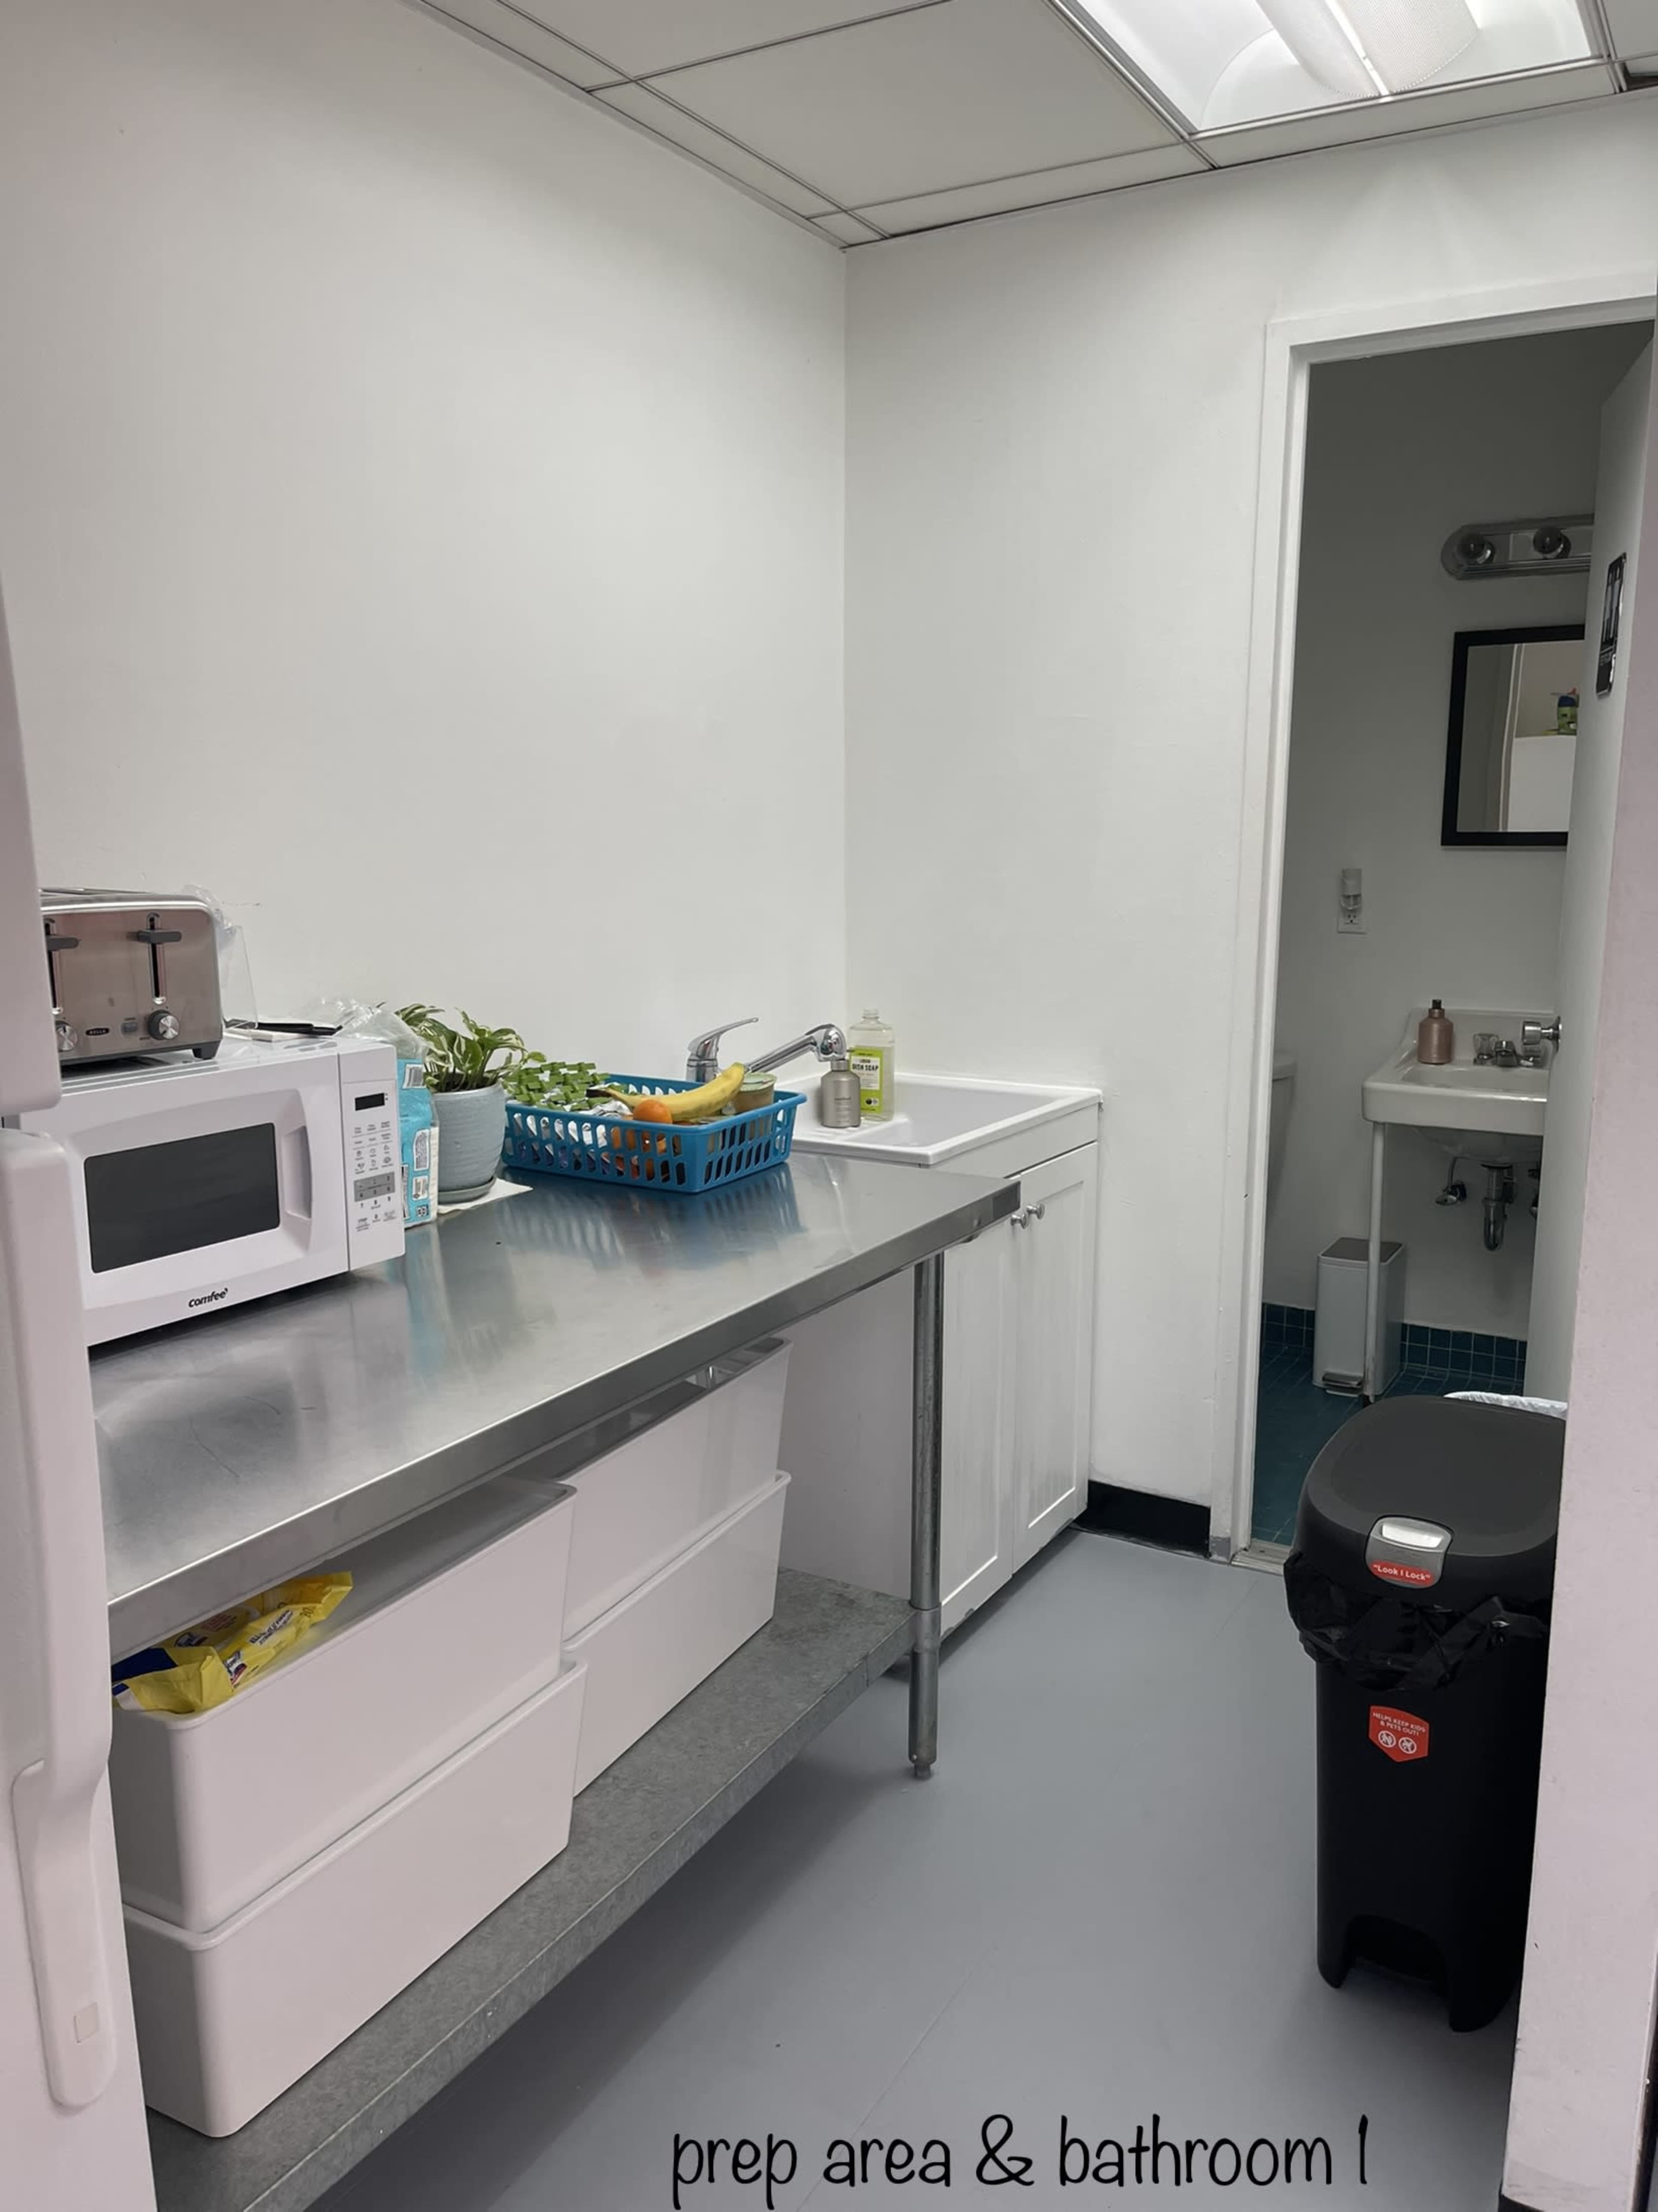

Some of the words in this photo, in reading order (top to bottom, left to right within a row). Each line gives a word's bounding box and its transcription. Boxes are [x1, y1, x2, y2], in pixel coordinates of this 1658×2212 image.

[1372, 1712, 1392, 1722] HELPS
[1392, 1719, 1409, 1728] KEEP
[1410, 1724, 1426, 1733] KIDS
[1386, 1722, 1402, 1731] PETS
